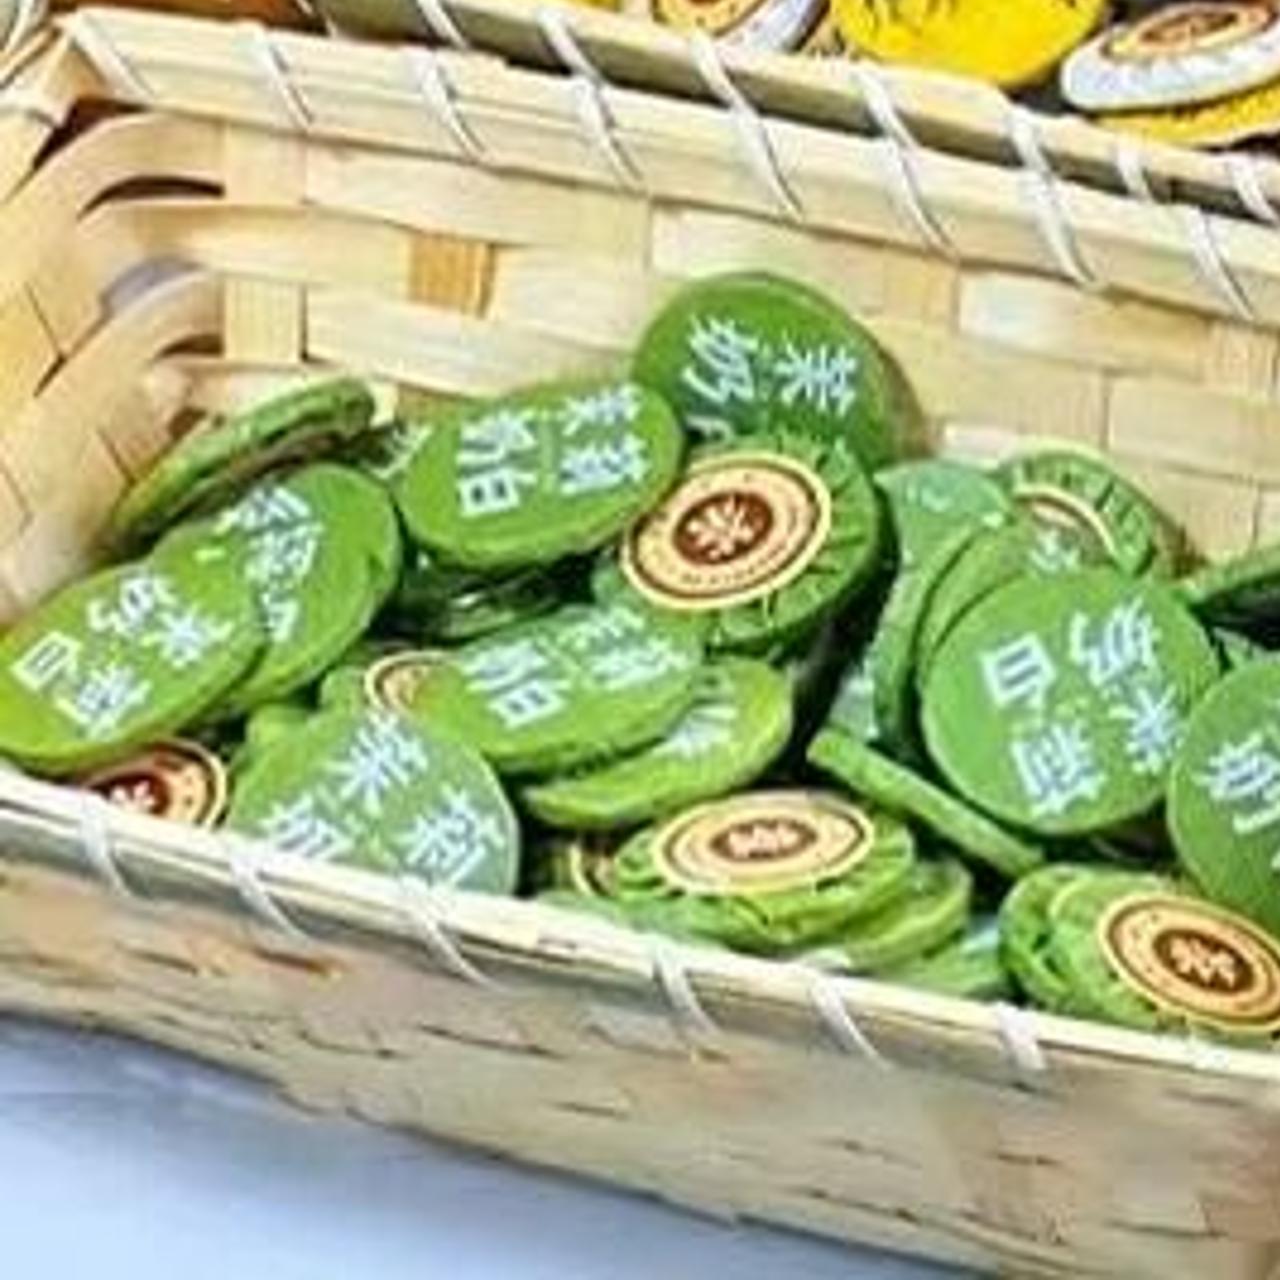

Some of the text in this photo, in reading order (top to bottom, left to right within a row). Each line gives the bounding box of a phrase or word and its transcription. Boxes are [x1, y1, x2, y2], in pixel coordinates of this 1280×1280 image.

[452, 408, 539, 517] 奶白
[978, 595, 1166, 712] 奶白
[1009, 684, 1188, 820] 茉莉
